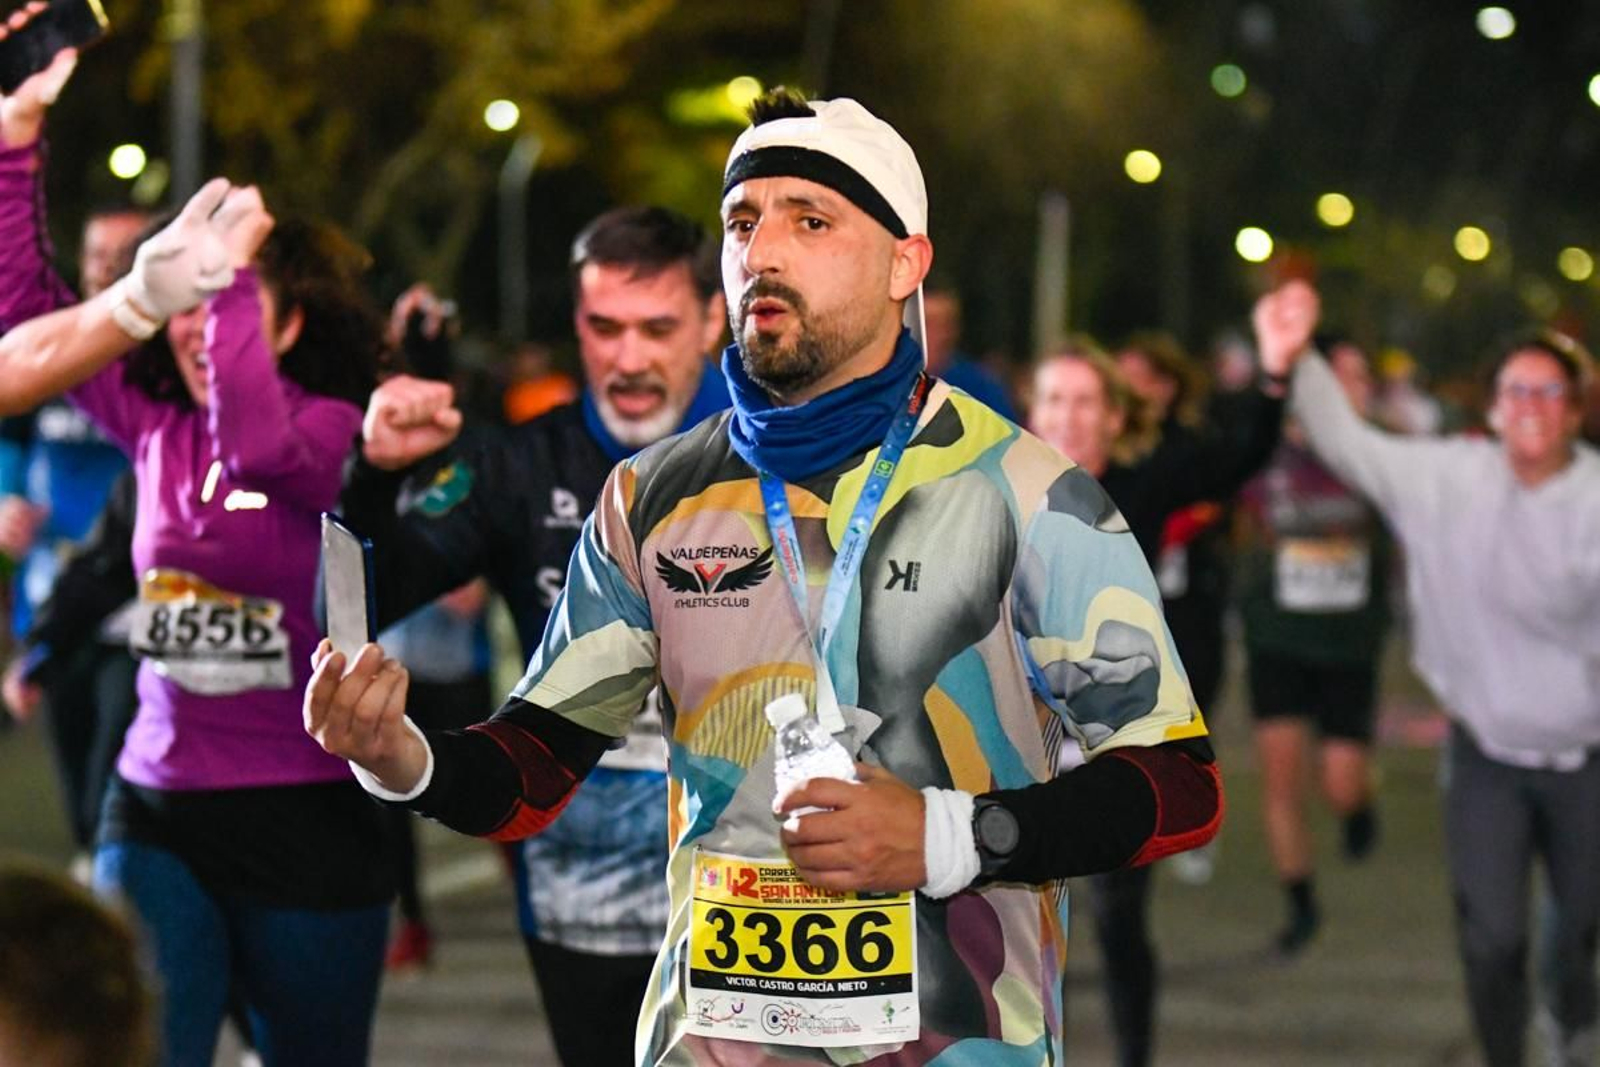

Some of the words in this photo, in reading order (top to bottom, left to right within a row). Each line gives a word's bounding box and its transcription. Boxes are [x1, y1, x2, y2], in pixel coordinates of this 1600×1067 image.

[670, 544, 760, 560] VALDEPEÑAS
[720, 597, 750, 608] CLUB
[148, 605, 272, 649] 8556
[759, 867, 797, 877] CARRER
[726, 867, 759, 898] 42
[760, 885, 790, 899] SAN
[704, 907, 895, 975] 3366
[725, 976, 758, 988] VICTOR
[759, 980, 795, 991] CASTRO
[797, 981, 835, 992] GARCÍA
[838, 981, 868, 992] NIETO
